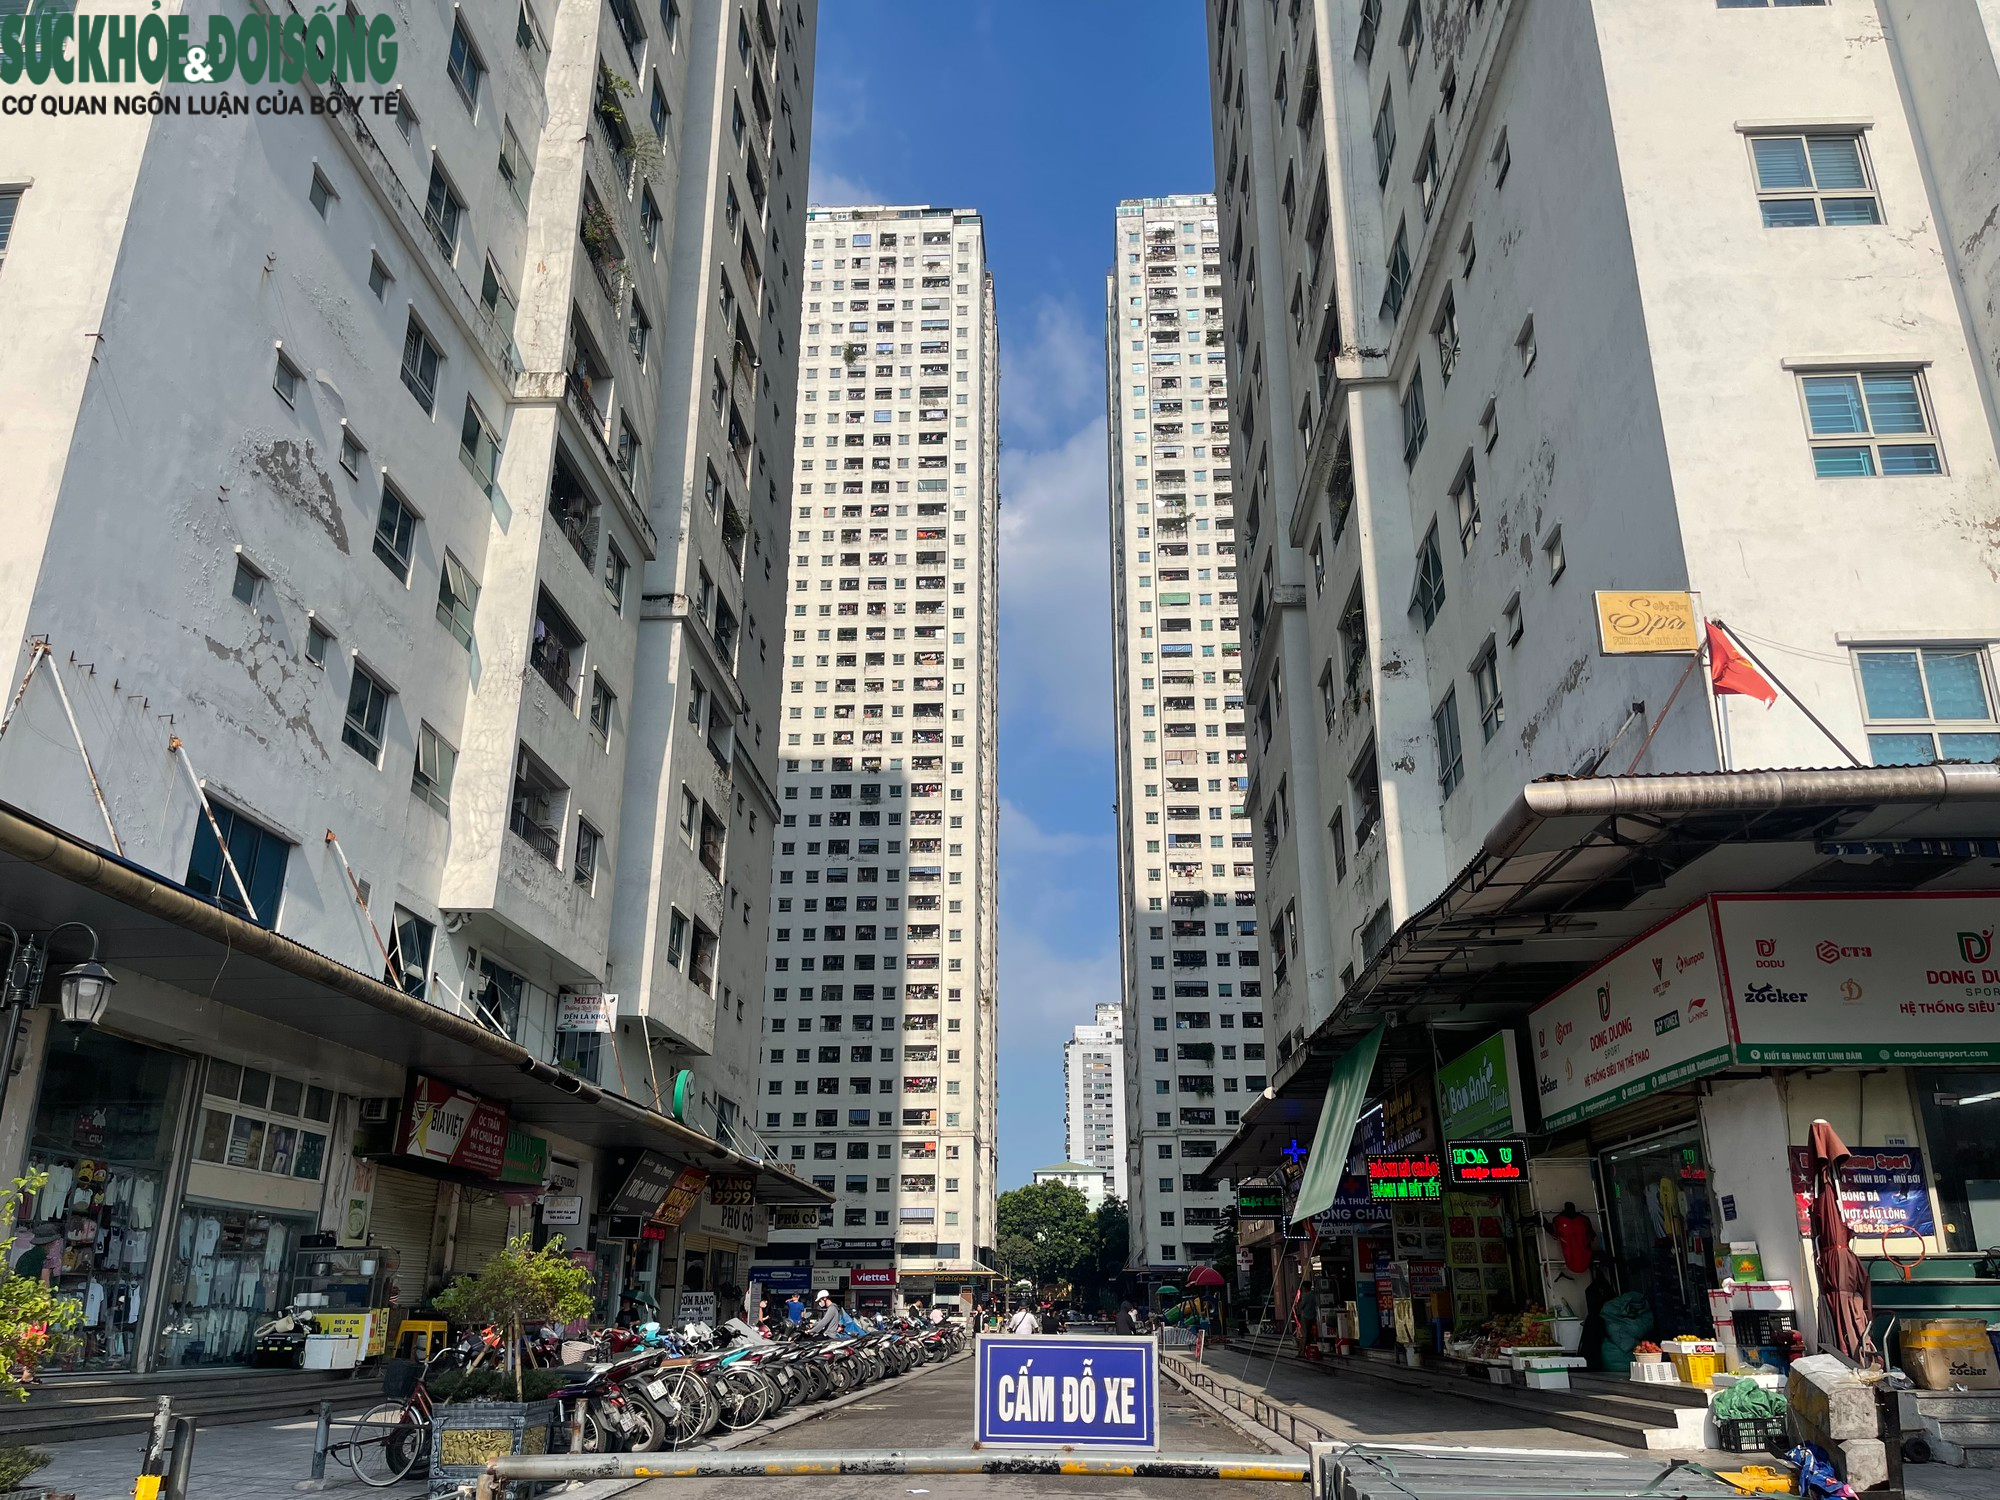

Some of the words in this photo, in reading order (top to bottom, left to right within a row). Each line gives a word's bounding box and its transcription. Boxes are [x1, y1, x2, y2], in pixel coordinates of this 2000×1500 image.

[1609, 598, 1686, 636] Spa
[1841, 946, 1872, 958] CT3
[1756, 960, 1785, 968] DODU
[1926, 970, 1976, 984] DONG
[1900, 1000, 1916, 1016] HỆ
[1919, 999, 1965, 1013] THỐNG
[1968, 1000, 1995, 1013] SIÊU
[1590, 1031, 1608, 1051] DONG
[1608, 1017, 1633, 1042] DUONG
[1893, 1049, 1989, 1060] dongduongsport.com
[1590, 1068, 1607, 1085] THỐNG
[1606, 1063, 1617, 1078] SIÊU
[1635, 1048, 1650, 1065] THAO
[1453, 1148, 1489, 1164] HOA
[1876, 1153, 1912, 1171] Sport
[1370, 1158, 1398, 1178] BÁNH
[1411, 1155, 1439, 1177] CHẢO
[716, 1178, 753, 1191] VÀNG
[1853, 1173, 1871, 1184] KÍNH
[1874, 1173, 1887, 1184] BƠI
[1893, 1172, 1907, 1184] MŨ
[1907, 1173, 1921, 1184] BƠI
[1372, 1179, 1397, 1198] BÁNH
[1409, 1179, 1422, 1197] BÍT
[1423, 1176, 1440, 1197] TẾT
[714, 1191, 752, 1205] 9999
[1841, 1190, 1866, 1202] BÓNG
[1867, 1190, 1880, 1202] ĐÁ
[777, 1210, 799, 1225] PHỞ
[802, 1208, 818, 1225] CỔ
[1355, 1206, 1392, 1221] CHÂU
[1844, 1208, 1861, 1220] VỢT
[1883, 1207, 1907, 1220] LÔNG
[856, 1273, 891, 1282] viettel
[695, 1295, 714, 1305] RANG
[998, 1359, 1055, 1422] CẤM
[1061, 1358, 1096, 1424] ĐỖ
[1103, 1377, 1136, 1424] XE
